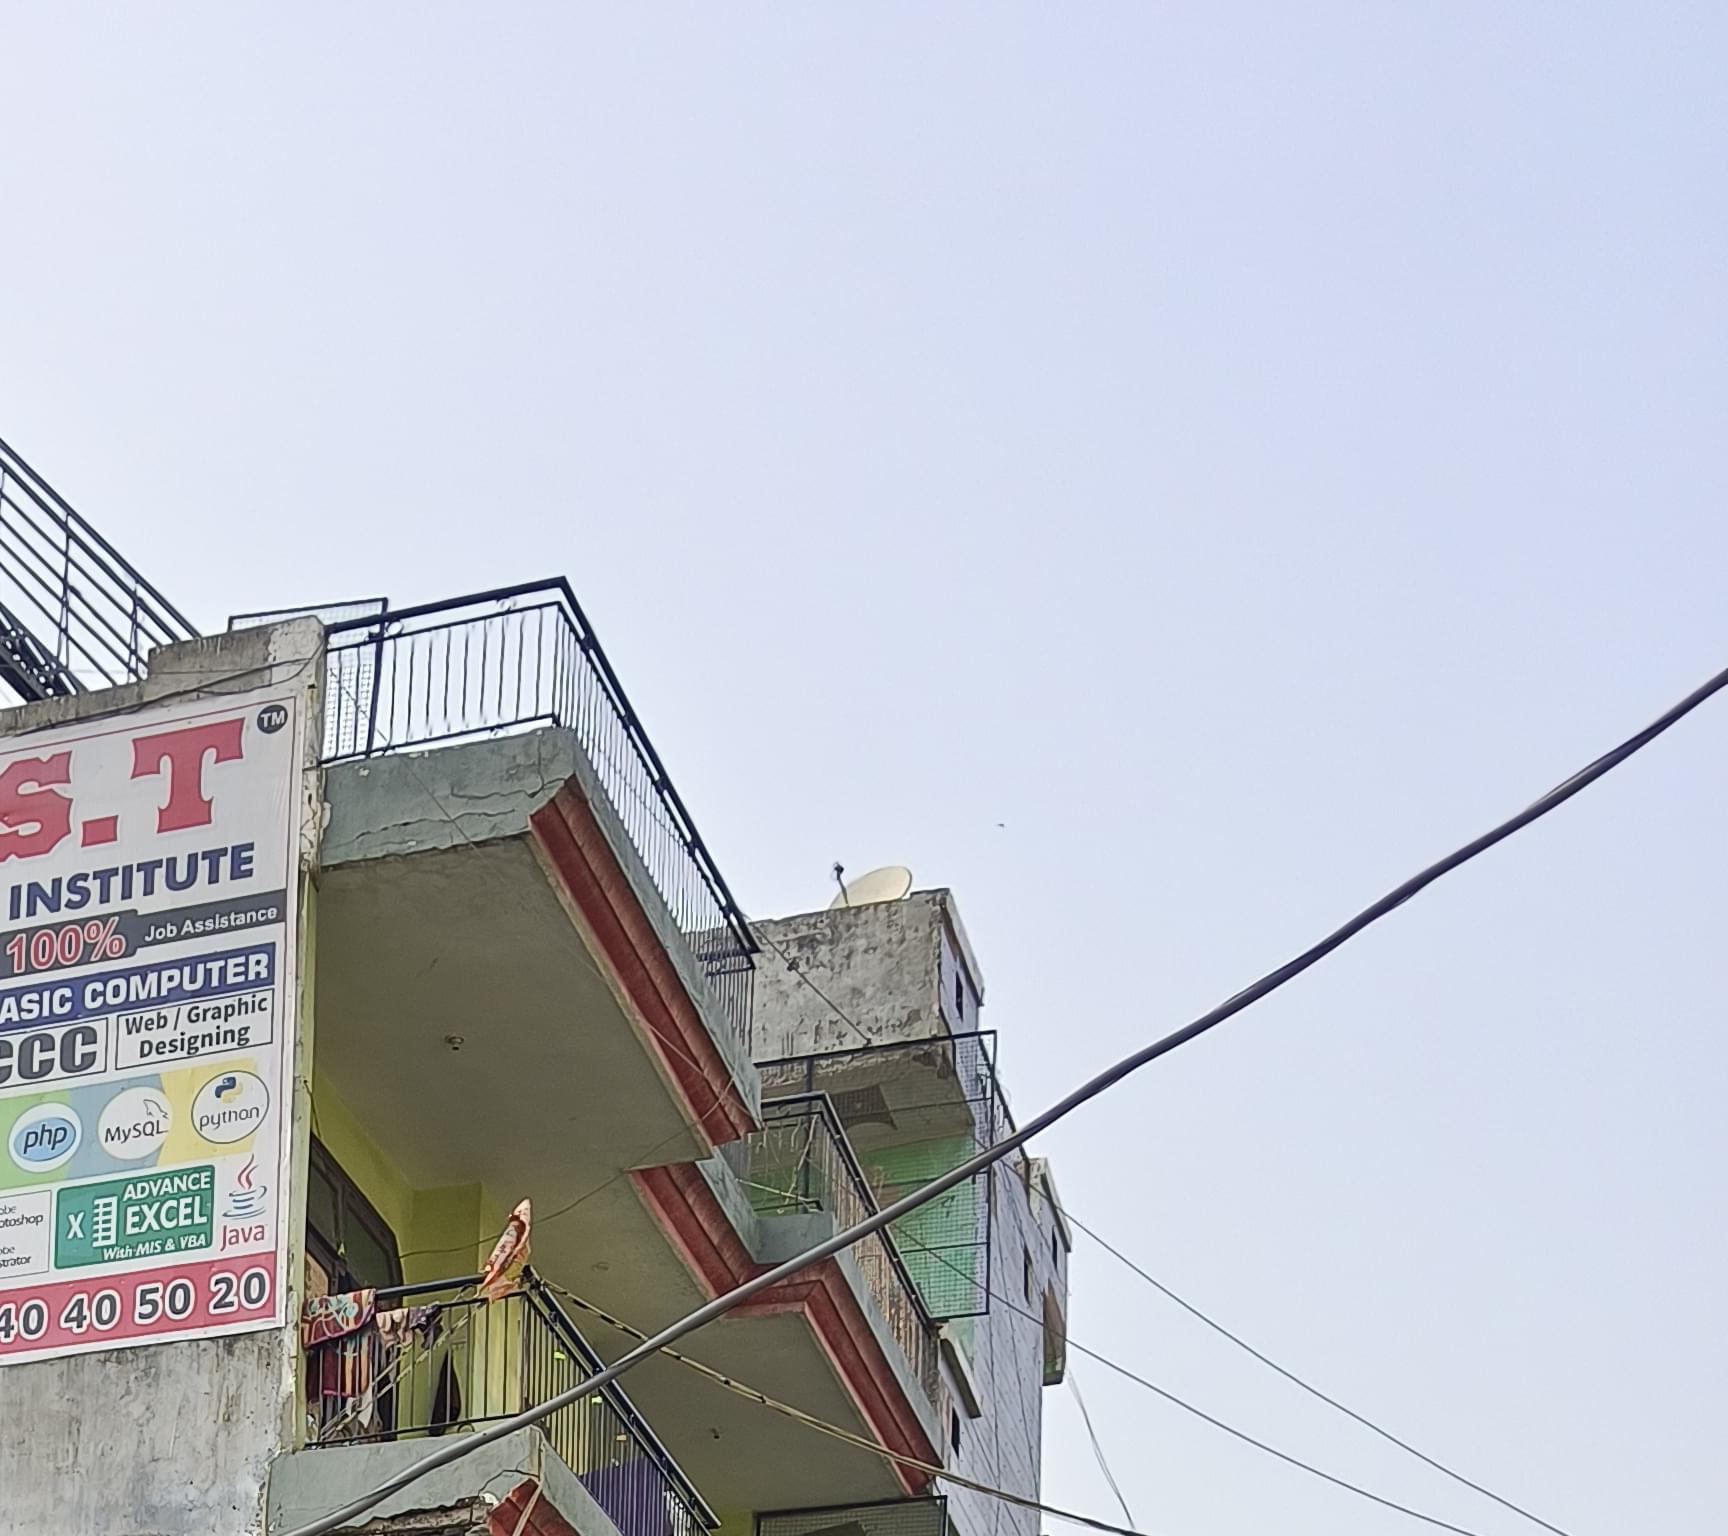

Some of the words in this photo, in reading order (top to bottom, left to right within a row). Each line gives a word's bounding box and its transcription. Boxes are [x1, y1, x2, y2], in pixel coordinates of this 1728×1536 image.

[9, 842, 256, 922] INSTITUTE
[6, 916, 127, 974] 100%
[144, 922, 178, 942] Job
[180, 906, 279, 936] Assistance
[84, 952, 269, 1010] COMPUTER
[124, 1011, 168, 1035] Web
[186, 994, 268, 1025] Graphic
[138, 1025, 251, 1059] Designing
[104, 1119, 169, 1144] MySQL
[199, 1105, 261, 1132] python
[23, 1123, 68, 1155] php
[123, 1172, 211, 1201] ADVANCE
[125, 1196, 207, 1235] EXCEL
[102, 1245, 133, 1261] With
[136, 1241, 162, 1257] MIS
[165, 1238, 176, 1252] &
[179, 1233, 207, 1250] VBA
[221, 1223, 266, 1252] Java
[64, 1293, 118, 1330] 40
[138, 1282, 192, 1320] 50
[212, 1271, 266, 1311] 20
